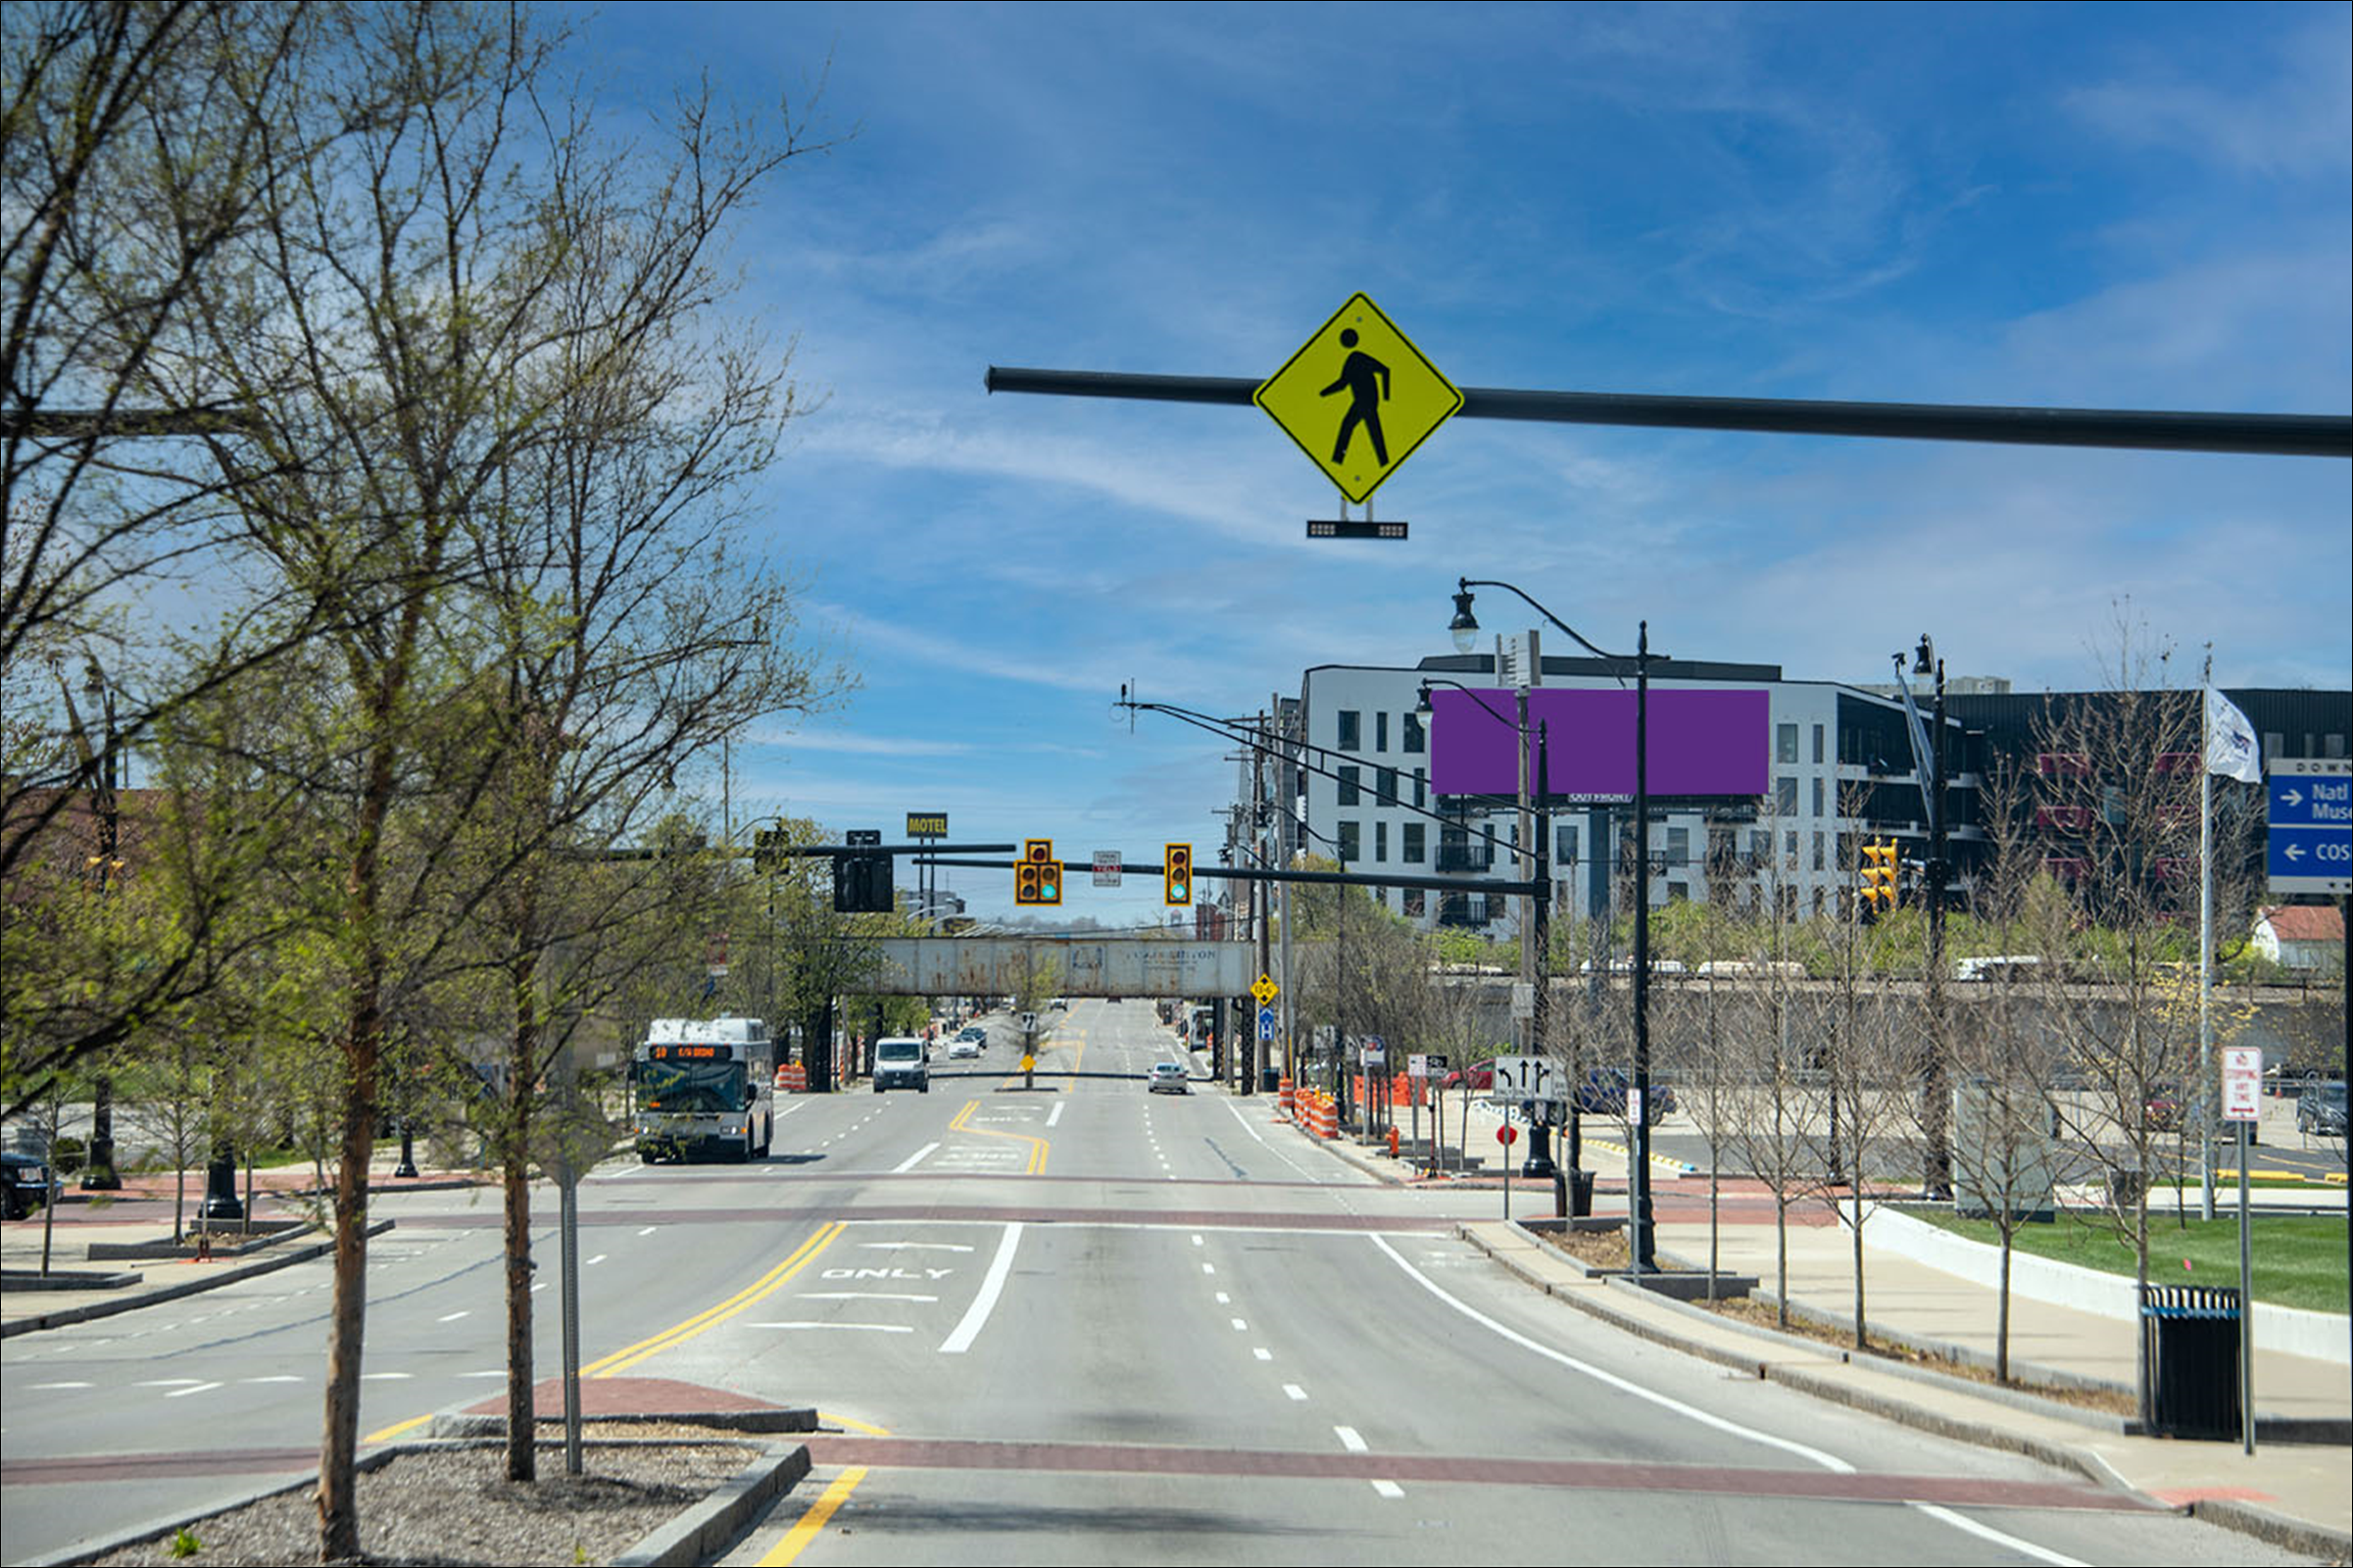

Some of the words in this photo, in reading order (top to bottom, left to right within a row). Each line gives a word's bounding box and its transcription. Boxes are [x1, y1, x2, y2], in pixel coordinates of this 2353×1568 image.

[2312, 783, 2348, 801] Natl
[908, 817, 947, 833] MOTEL
[1261, 1024, 1273, 1039] H
[821, 1268, 954, 1279] ONLY
